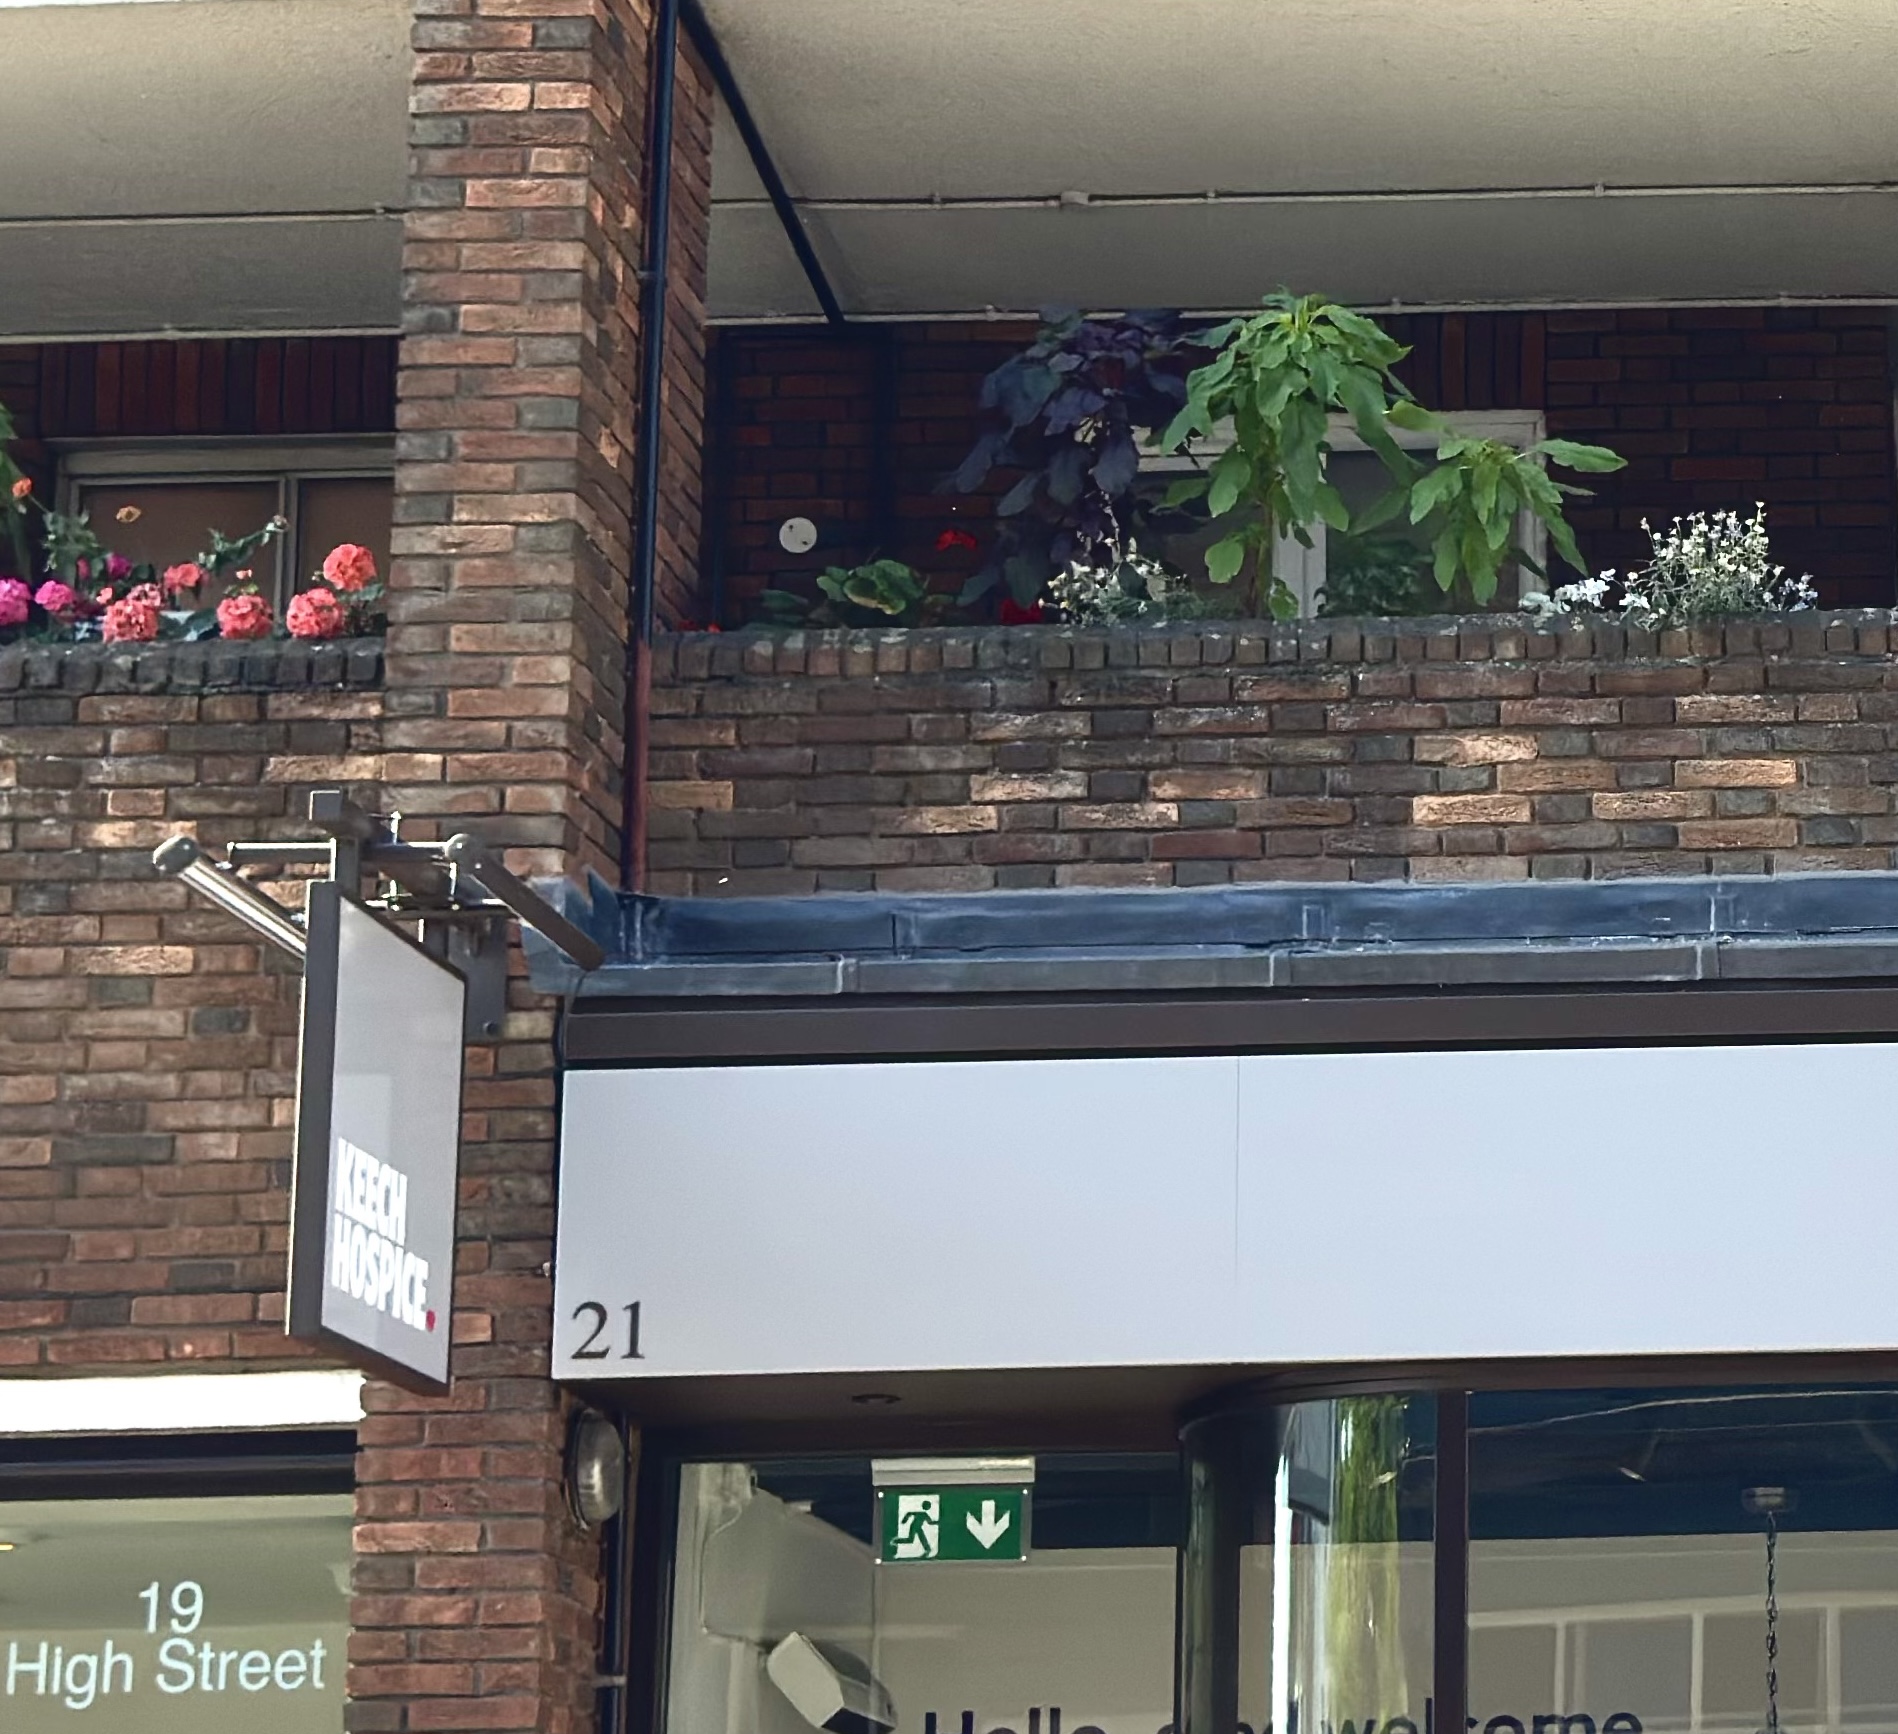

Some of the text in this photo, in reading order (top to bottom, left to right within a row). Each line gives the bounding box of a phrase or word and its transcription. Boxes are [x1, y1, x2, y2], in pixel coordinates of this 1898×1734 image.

[335, 1137, 407, 1246] KEECH
[570, 1300, 645, 1360] 21
[138, 1581, 204, 1634] 19
[6, 1637, 327, 1709] High Street
